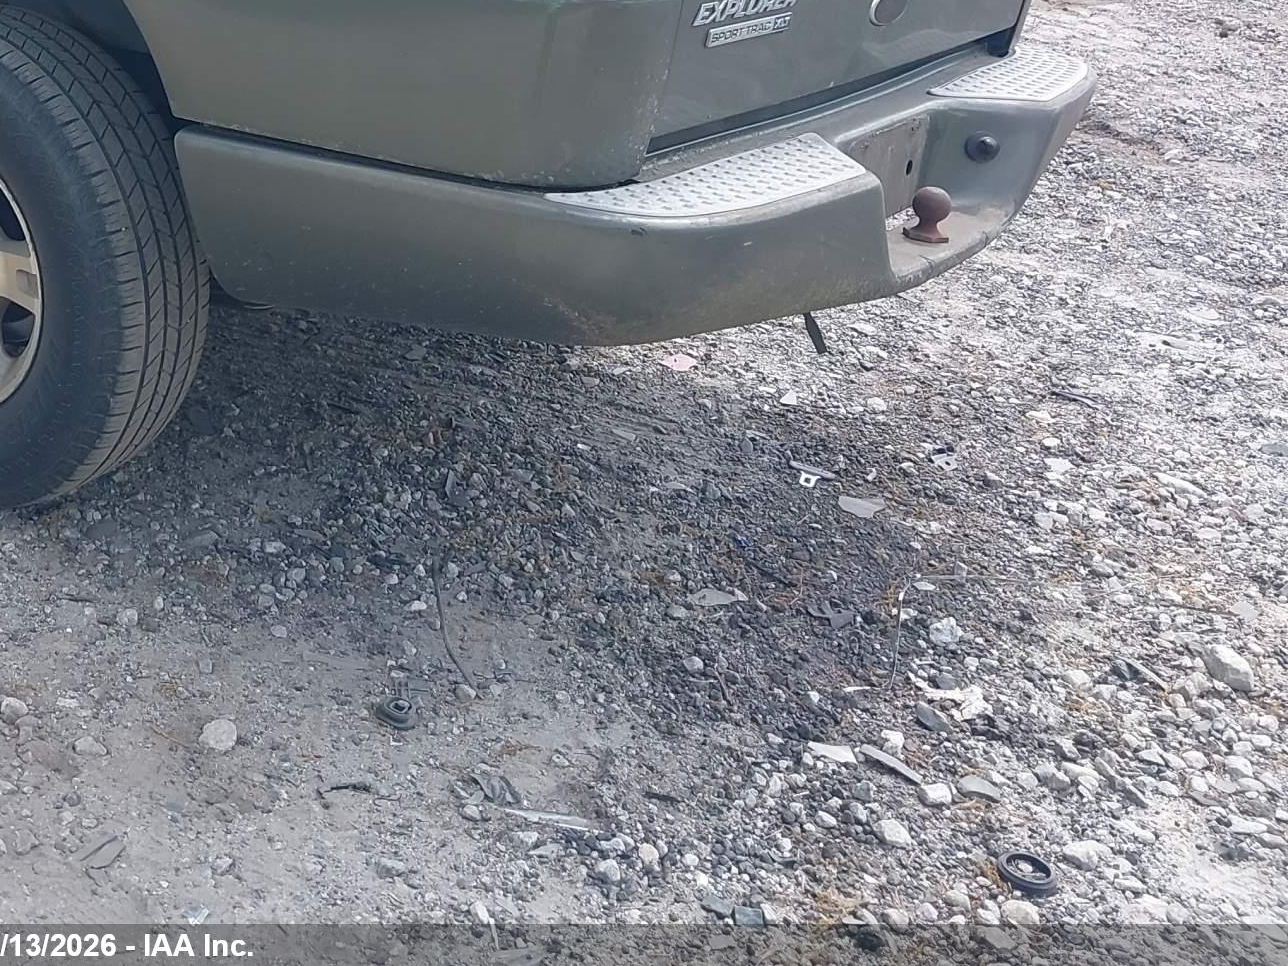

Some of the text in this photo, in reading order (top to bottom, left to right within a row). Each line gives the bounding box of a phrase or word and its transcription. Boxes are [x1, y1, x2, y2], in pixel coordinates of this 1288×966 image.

[711, 16, 792, 43] SPORT TRAC XLT
